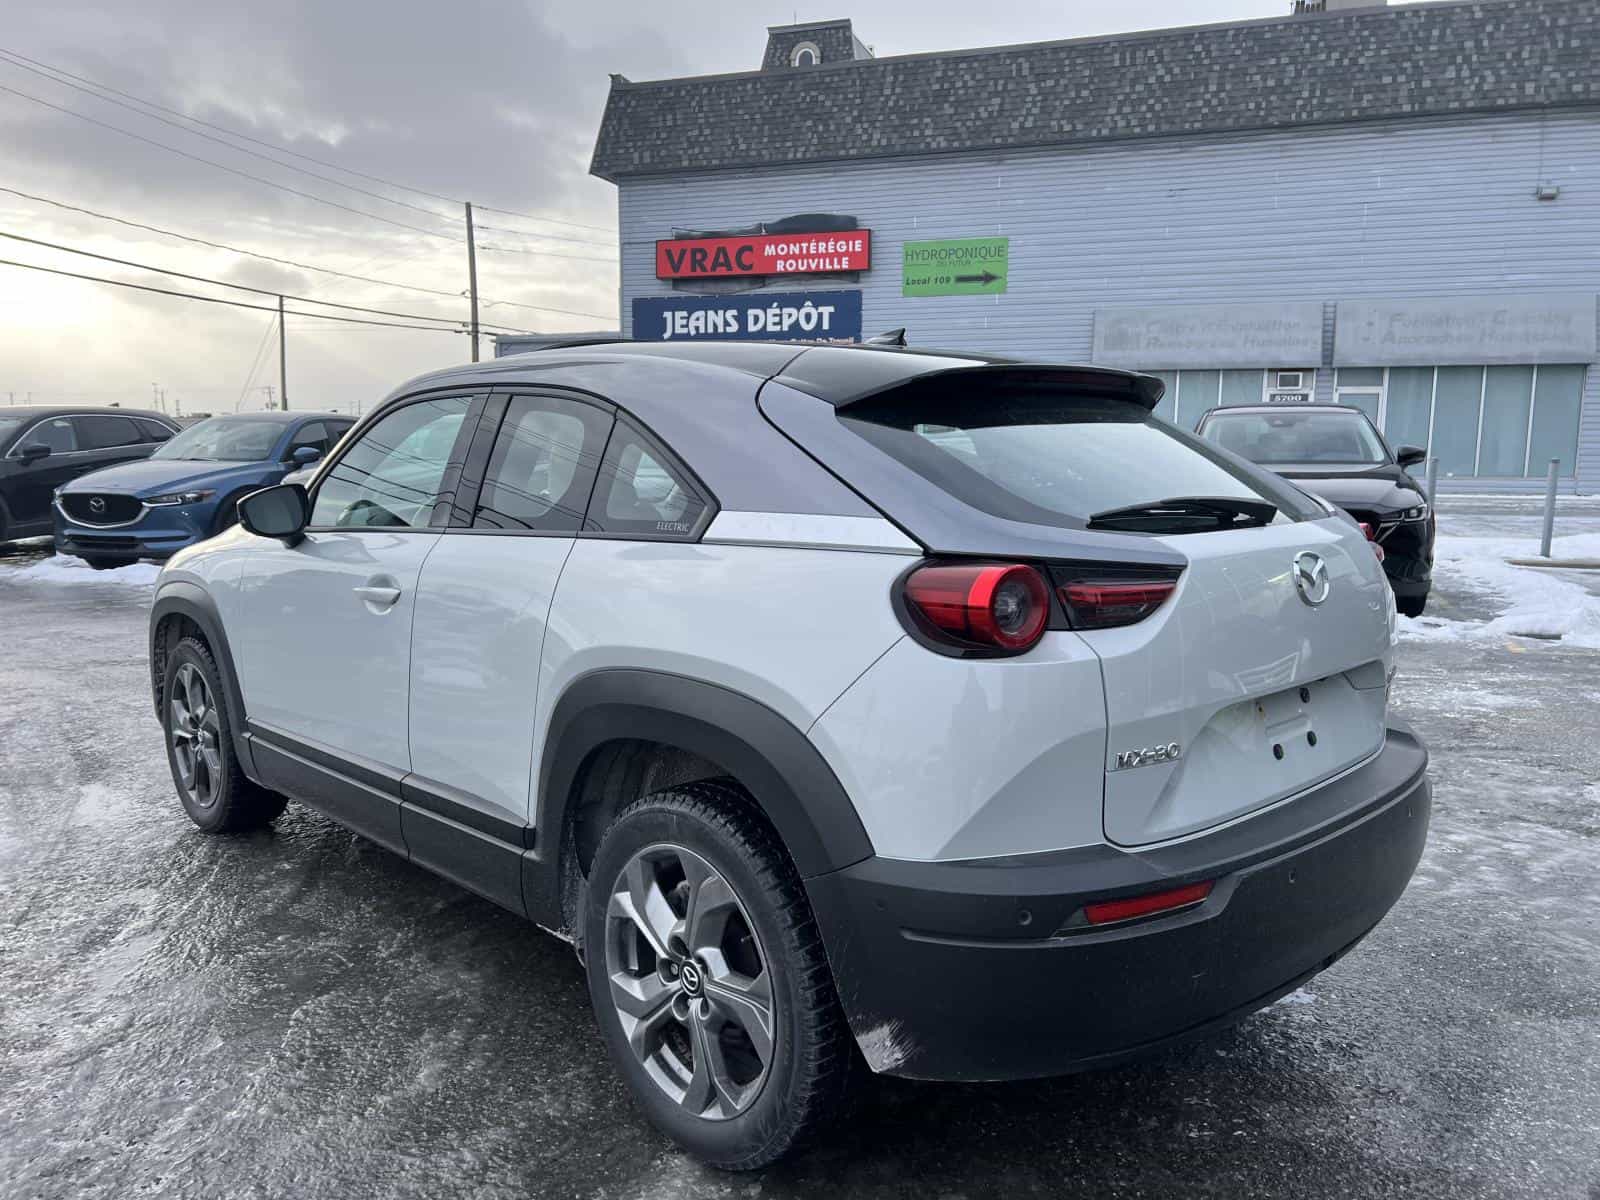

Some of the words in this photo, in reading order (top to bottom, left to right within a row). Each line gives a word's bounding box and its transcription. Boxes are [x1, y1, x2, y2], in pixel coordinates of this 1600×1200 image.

[765, 239, 863, 257] MONTÉRÉGIE
[905, 246, 1005, 262] HYDROPONIQUE
[665, 245, 754, 273] VRAC
[776, 257, 850, 272] ROUVILLE
[906, 277, 930, 285] Local
[934, 276, 951, 284] 109
[663, 308, 738, 339] JEANS
[747, 301, 834, 333] DÉPÔT
[656, 521, 689, 533] ELECTRIC
[1115, 743, 1182, 770] MX-30
